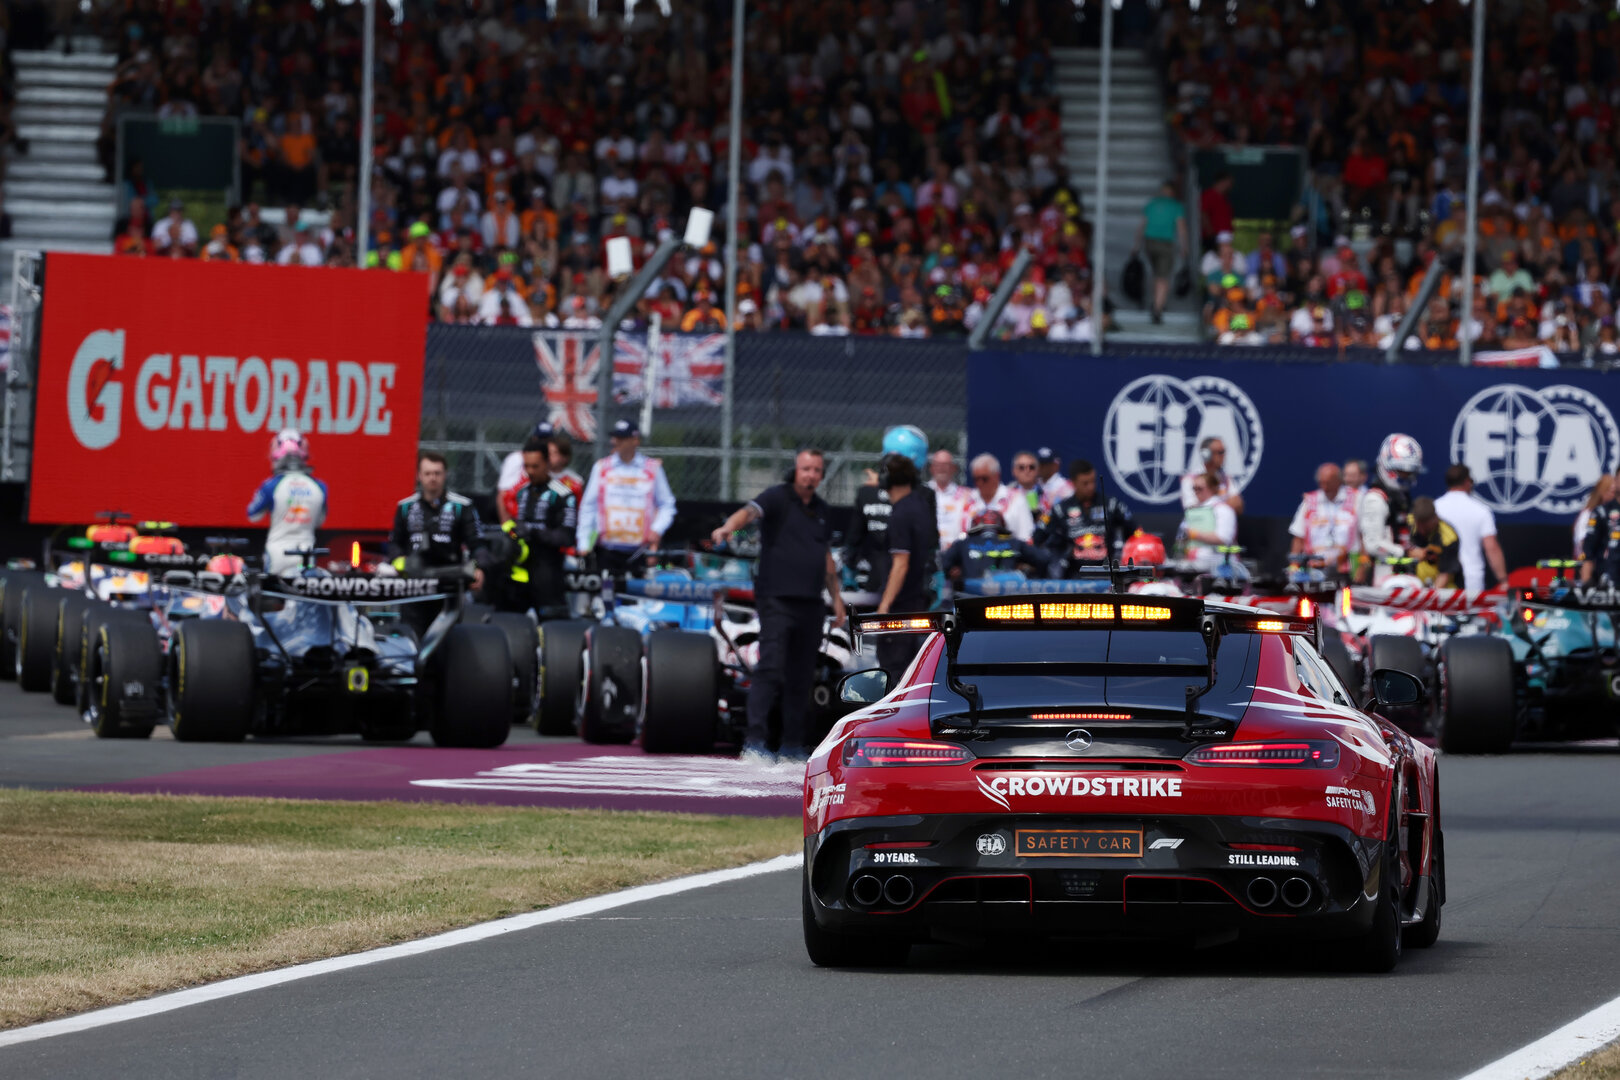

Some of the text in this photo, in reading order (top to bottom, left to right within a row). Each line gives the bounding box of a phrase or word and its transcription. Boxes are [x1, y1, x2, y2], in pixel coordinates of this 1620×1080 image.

[67, 329, 125, 449] G
[134, 353, 396, 436] GATORADE
[292, 577, 439, 597] CROWDSTRIKE
[990, 776, 1182, 797] CROWDSTRIKE
[833, 794, 845, 805] CAR
[1326, 796, 1352, 809] SAFETY
[1027, 836, 1131, 849] SAFETY CAR
[874, 853, 918, 863] 30 YEARS.
[1228, 854, 1299, 866] STILL LEADING.
